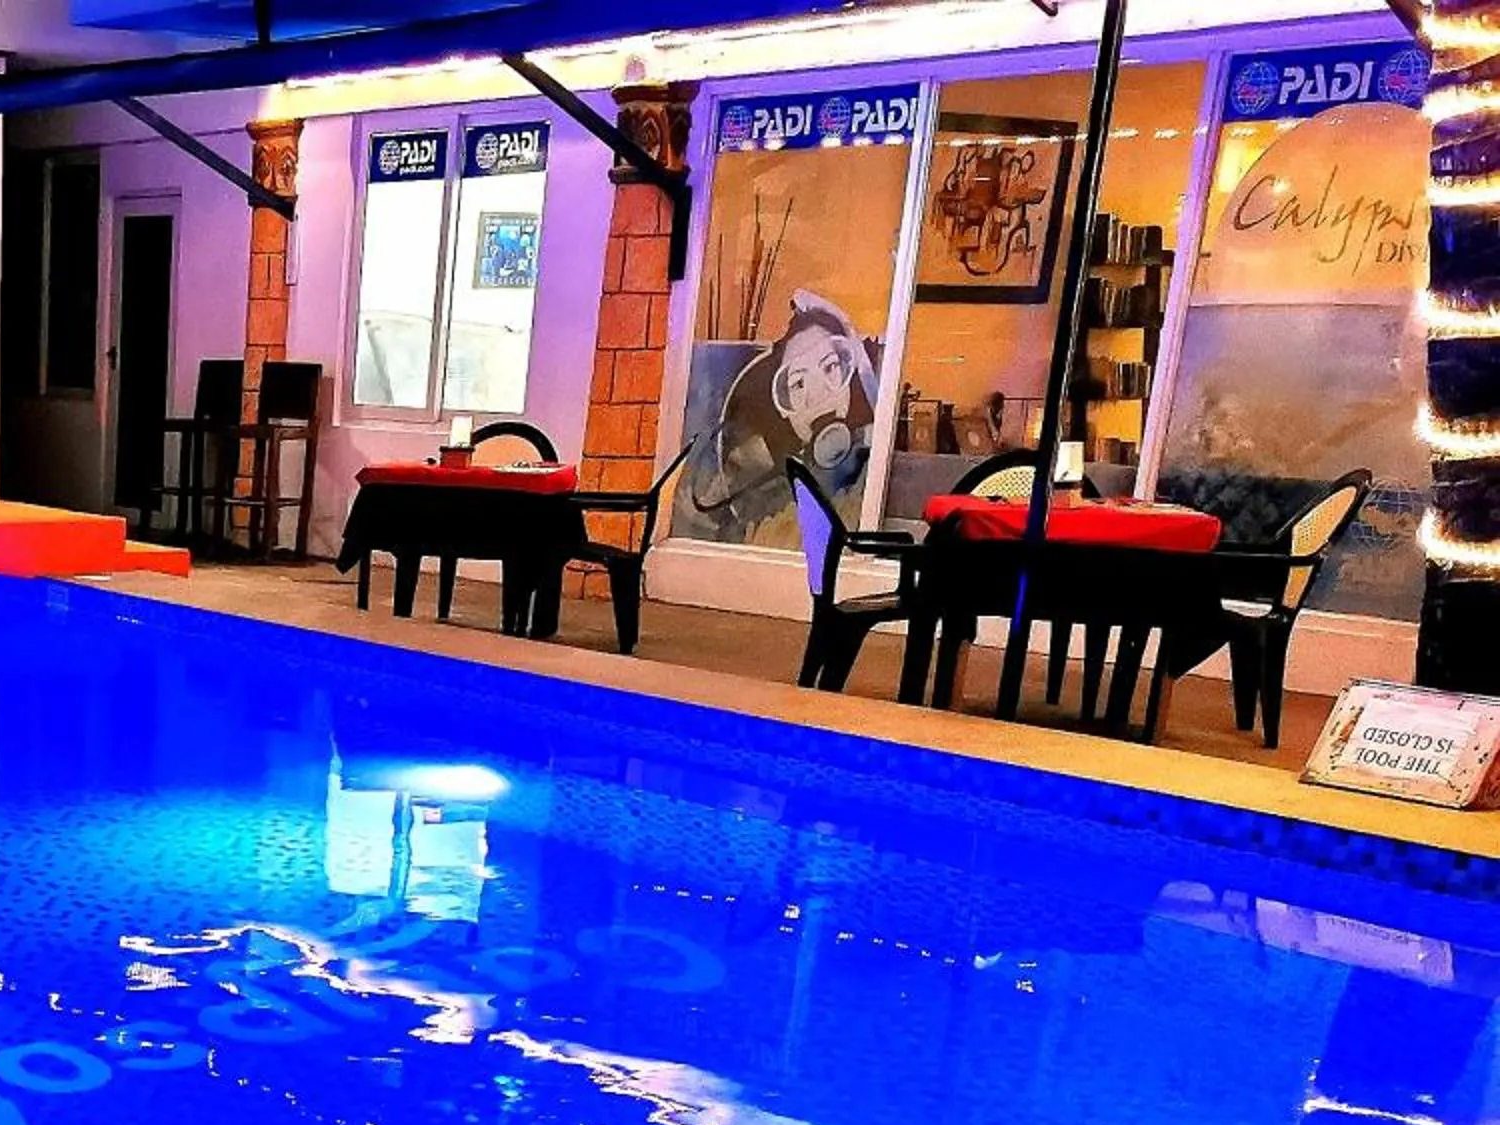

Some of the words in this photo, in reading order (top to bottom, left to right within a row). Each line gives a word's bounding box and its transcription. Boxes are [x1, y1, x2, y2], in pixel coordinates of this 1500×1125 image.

[1279, 60, 1375, 105] PADI
[752, 104, 813, 138] PADI
[852, 98, 918, 133] PADI
[400, 140, 437, 164] PADI
[499, 130, 540, 156] PADI
[1363, 727, 1433, 750] CLOSED
[1434, 738, 1455, 754] IS
[1355, 747, 1402, 769] POOL
[1403, 755, 1441, 775] THE
